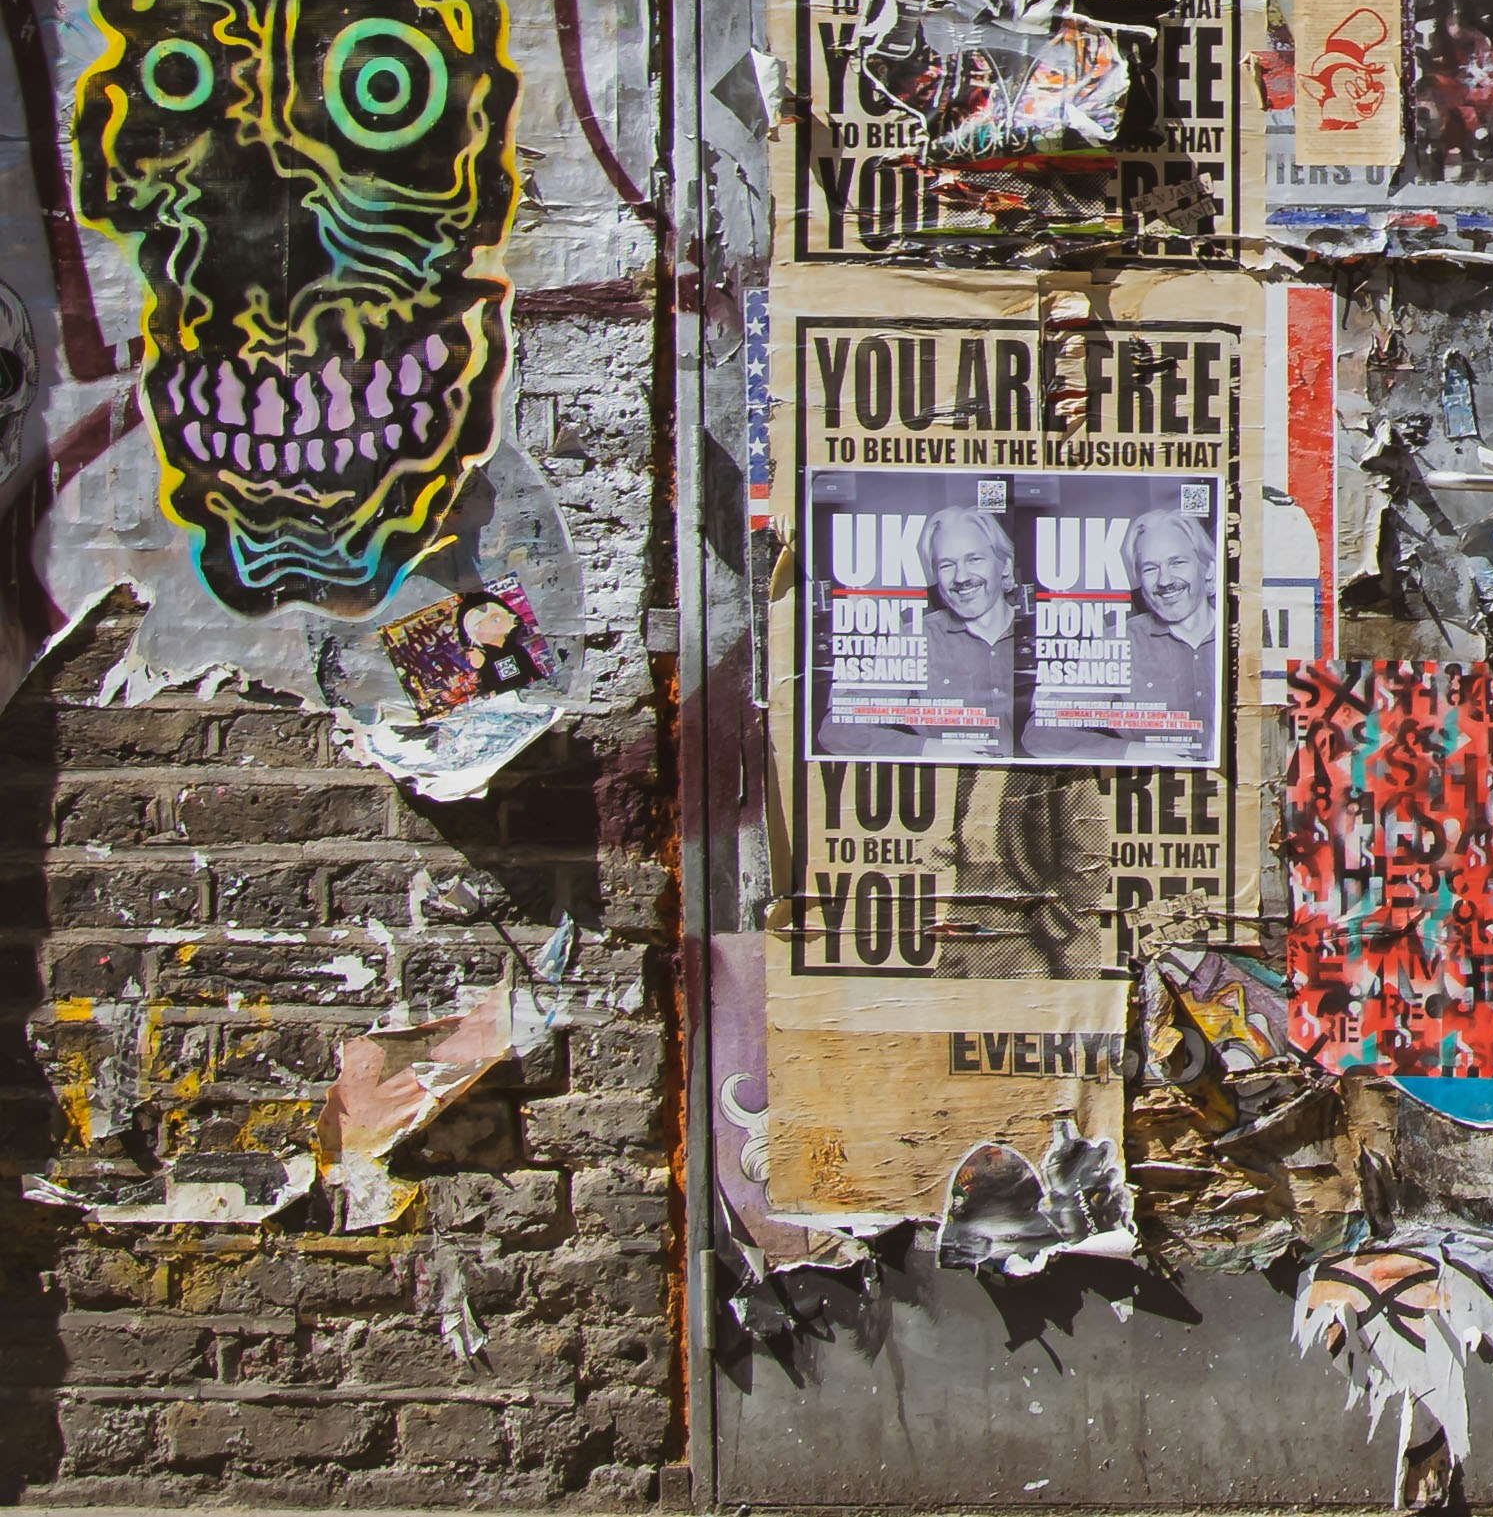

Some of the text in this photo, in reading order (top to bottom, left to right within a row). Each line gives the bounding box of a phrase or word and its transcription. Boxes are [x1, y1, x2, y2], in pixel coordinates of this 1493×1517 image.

[831, 122, 1224, 153] TO THAT
[818, 158, 939, 252] YOU
[814, 336, 937, 431] YOU
[826, 437, 1222, 469] TO BELIEVE IN THE ILLUSION THAT
[832, 513, 1131, 590] UK UK
[832, 599, 928, 635] DON'T
[1036, 603, 1131, 639] DON'T
[832, 635, 928, 657] EXTRADITE
[1036, 638, 1131, 661] EXTRADITE
[832, 658, 928, 682] ASSANGE
[1036, 661, 1131, 686] ASSANGE
[821, 763, 936, 833] YOU
[826, 837, 1218, 869] TO THAT
[815, 872, 936, 967] YOU
